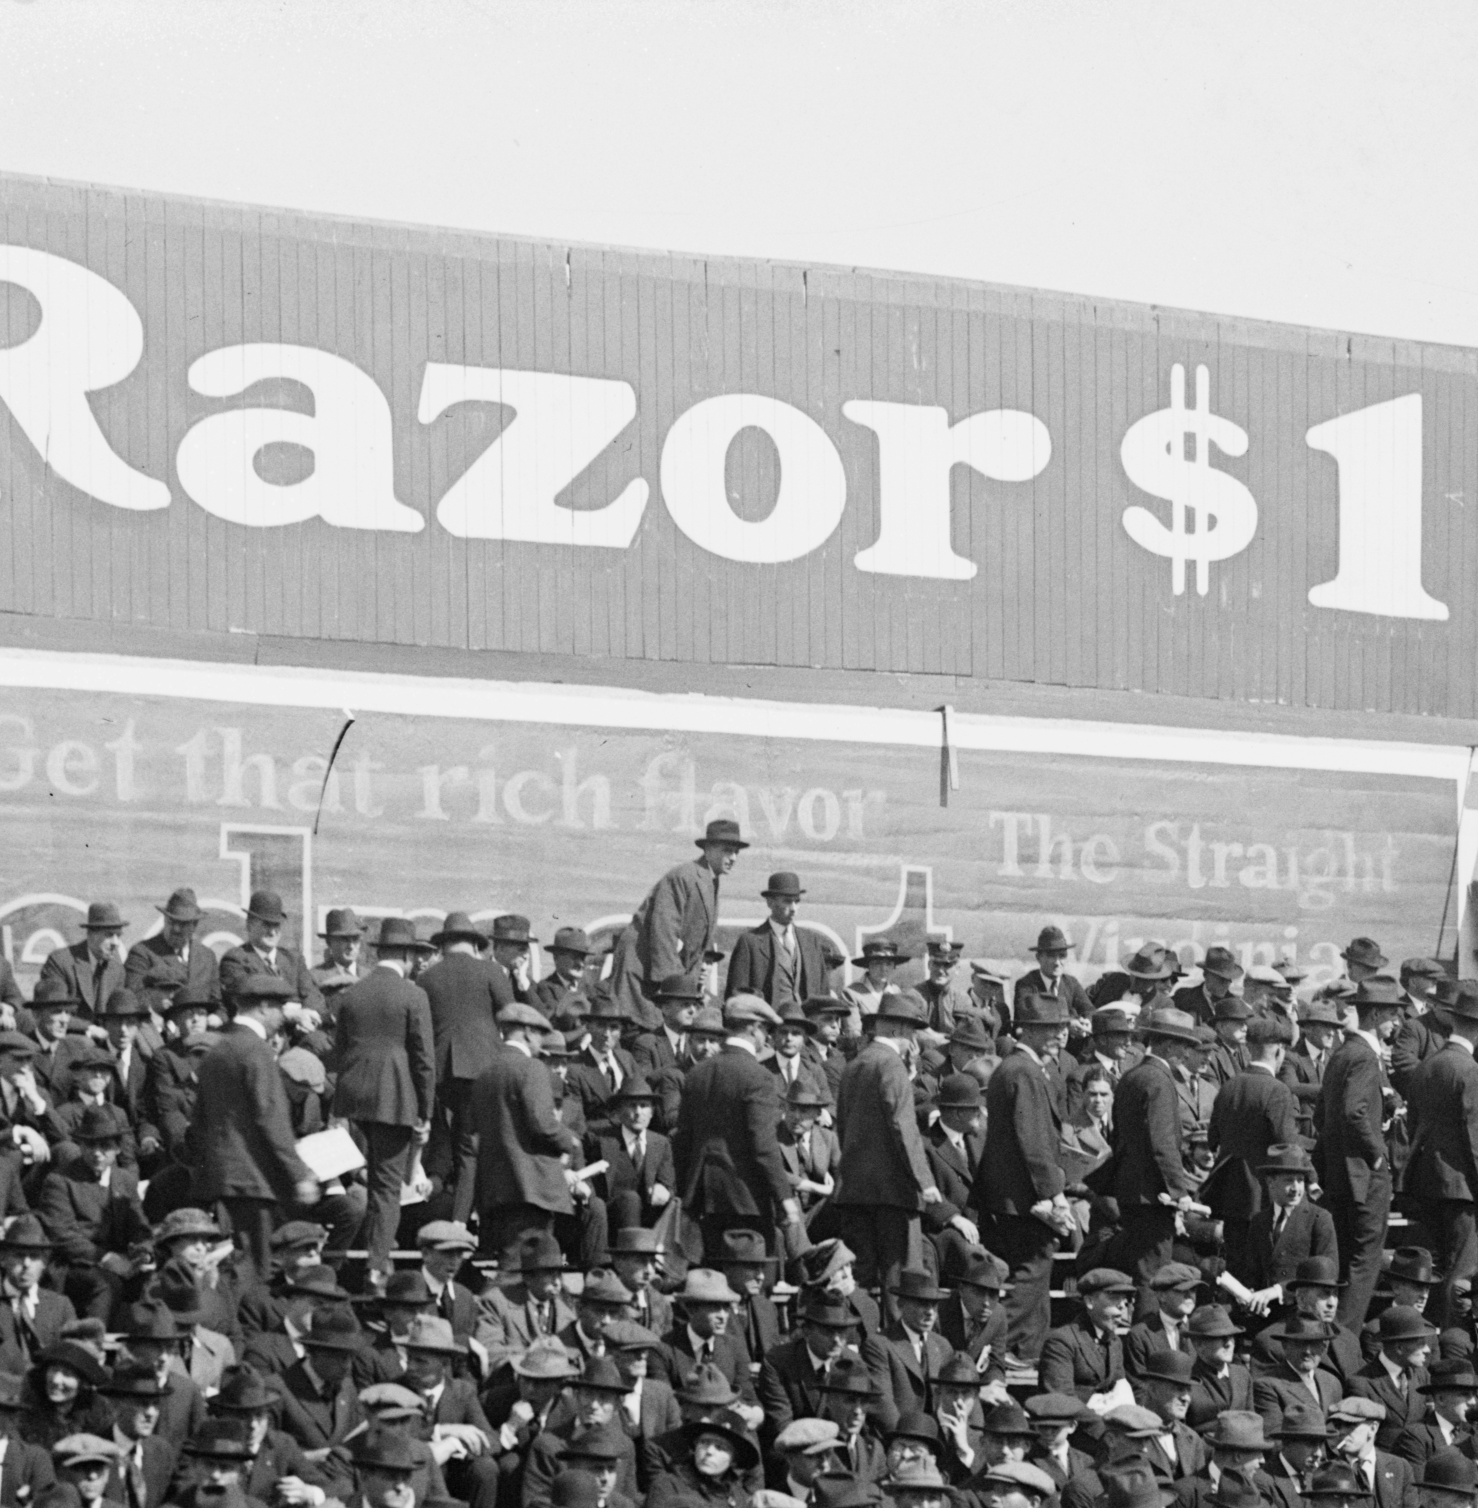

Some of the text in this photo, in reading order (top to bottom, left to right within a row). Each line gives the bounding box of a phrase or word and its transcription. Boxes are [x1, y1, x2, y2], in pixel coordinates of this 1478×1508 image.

[176, 721, 387, 818] that
[416, 743, 617, 830] rich
[640, 748, 885, 842] flavor
[988, 810, 1401, 911] The Straight
